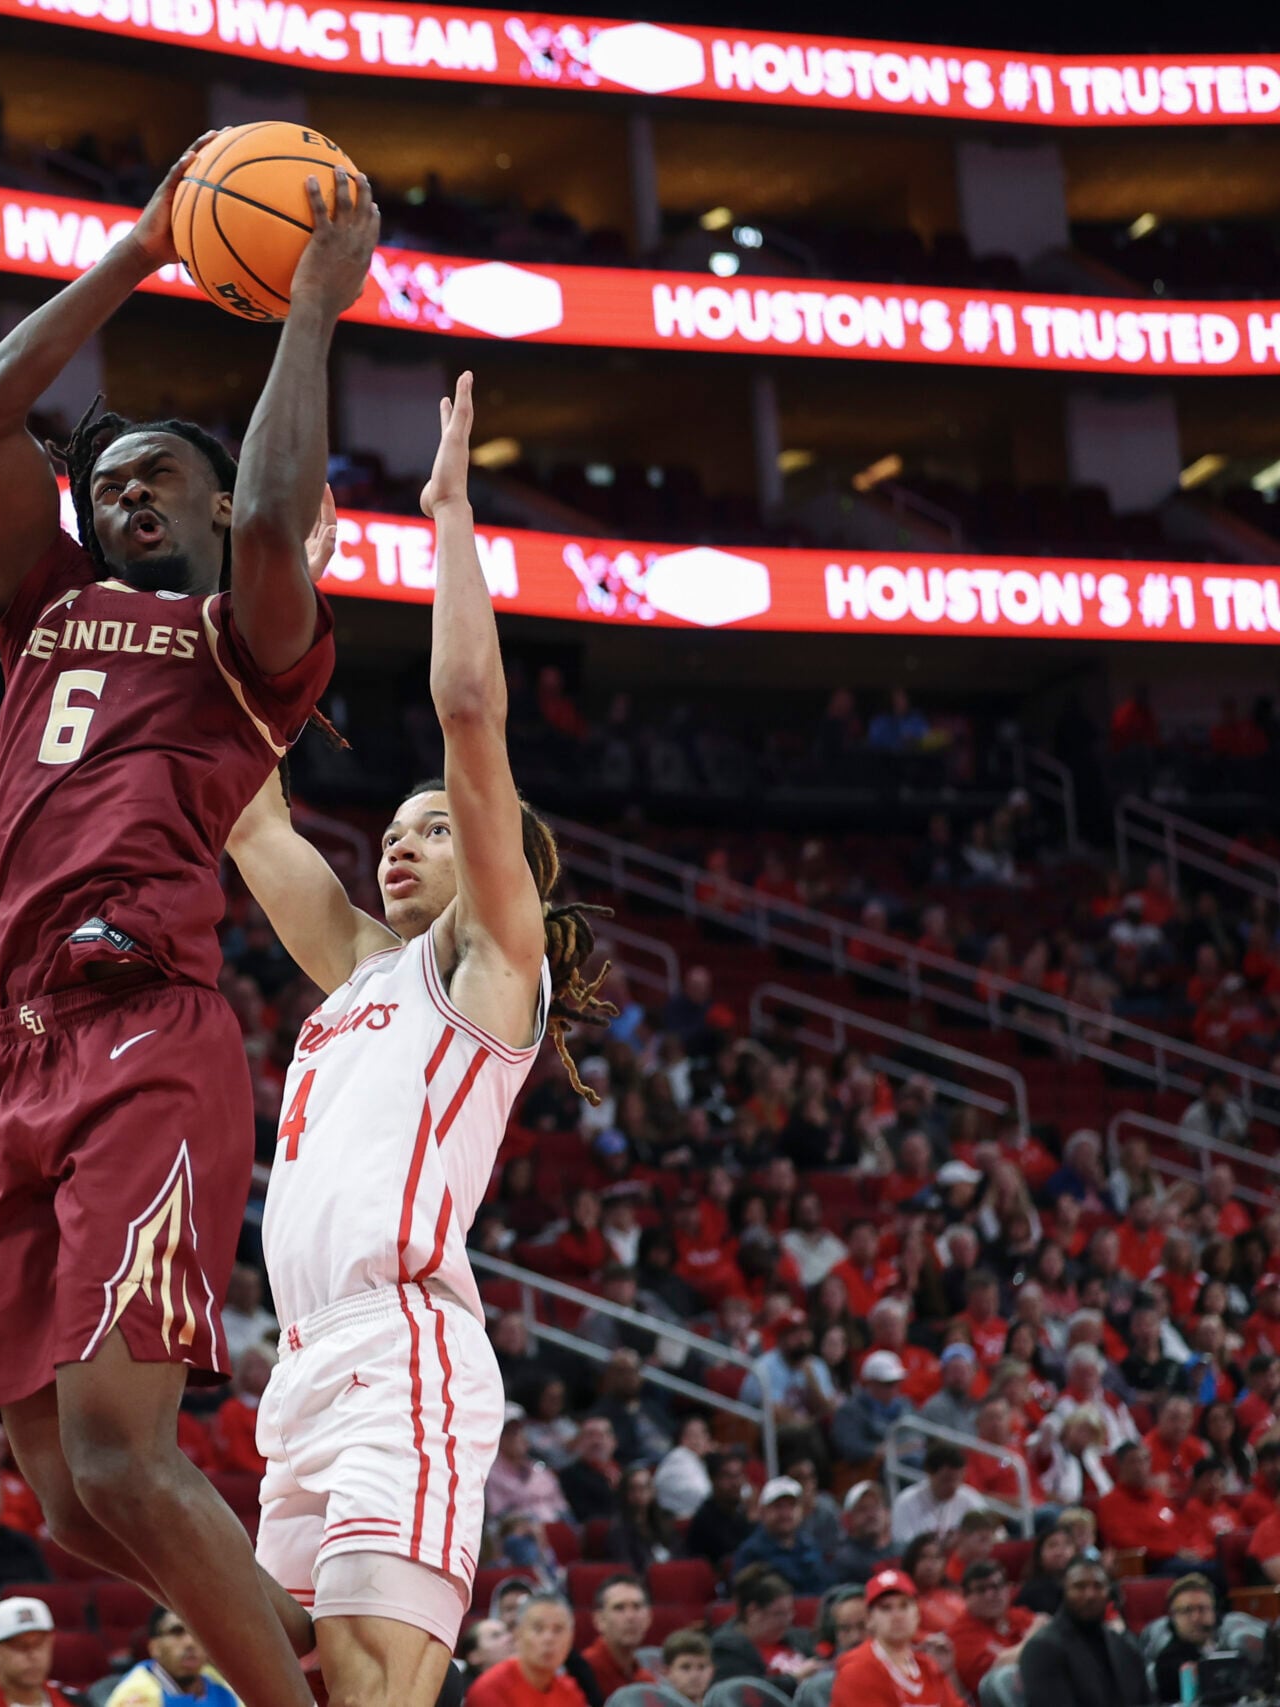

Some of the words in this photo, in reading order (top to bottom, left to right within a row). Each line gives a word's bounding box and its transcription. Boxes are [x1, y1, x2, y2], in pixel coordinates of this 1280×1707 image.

[218, 0, 348, 60] HVAC
[349, 12, 497, 72] TEAM
[712, 39, 994, 109] HOUSTON'S
[1000, 60, 1054, 115] #1
[1060, 65, 1280, 116] TRUSTED
[652, 283, 953, 352] HOUSTON'S
[959, 301, 1016, 356] #1
[1022, 305, 1240, 364] TRUSTED
[365, 521, 519, 598] TEM
[824, 563, 1132, 628] HOUSTON'S
[1138, 572, 1196, 630] #1
[21, 619, 199, 660] EINOLES
[37, 668, 108, 765] 6
[277, 1069, 318, 1162] 4
